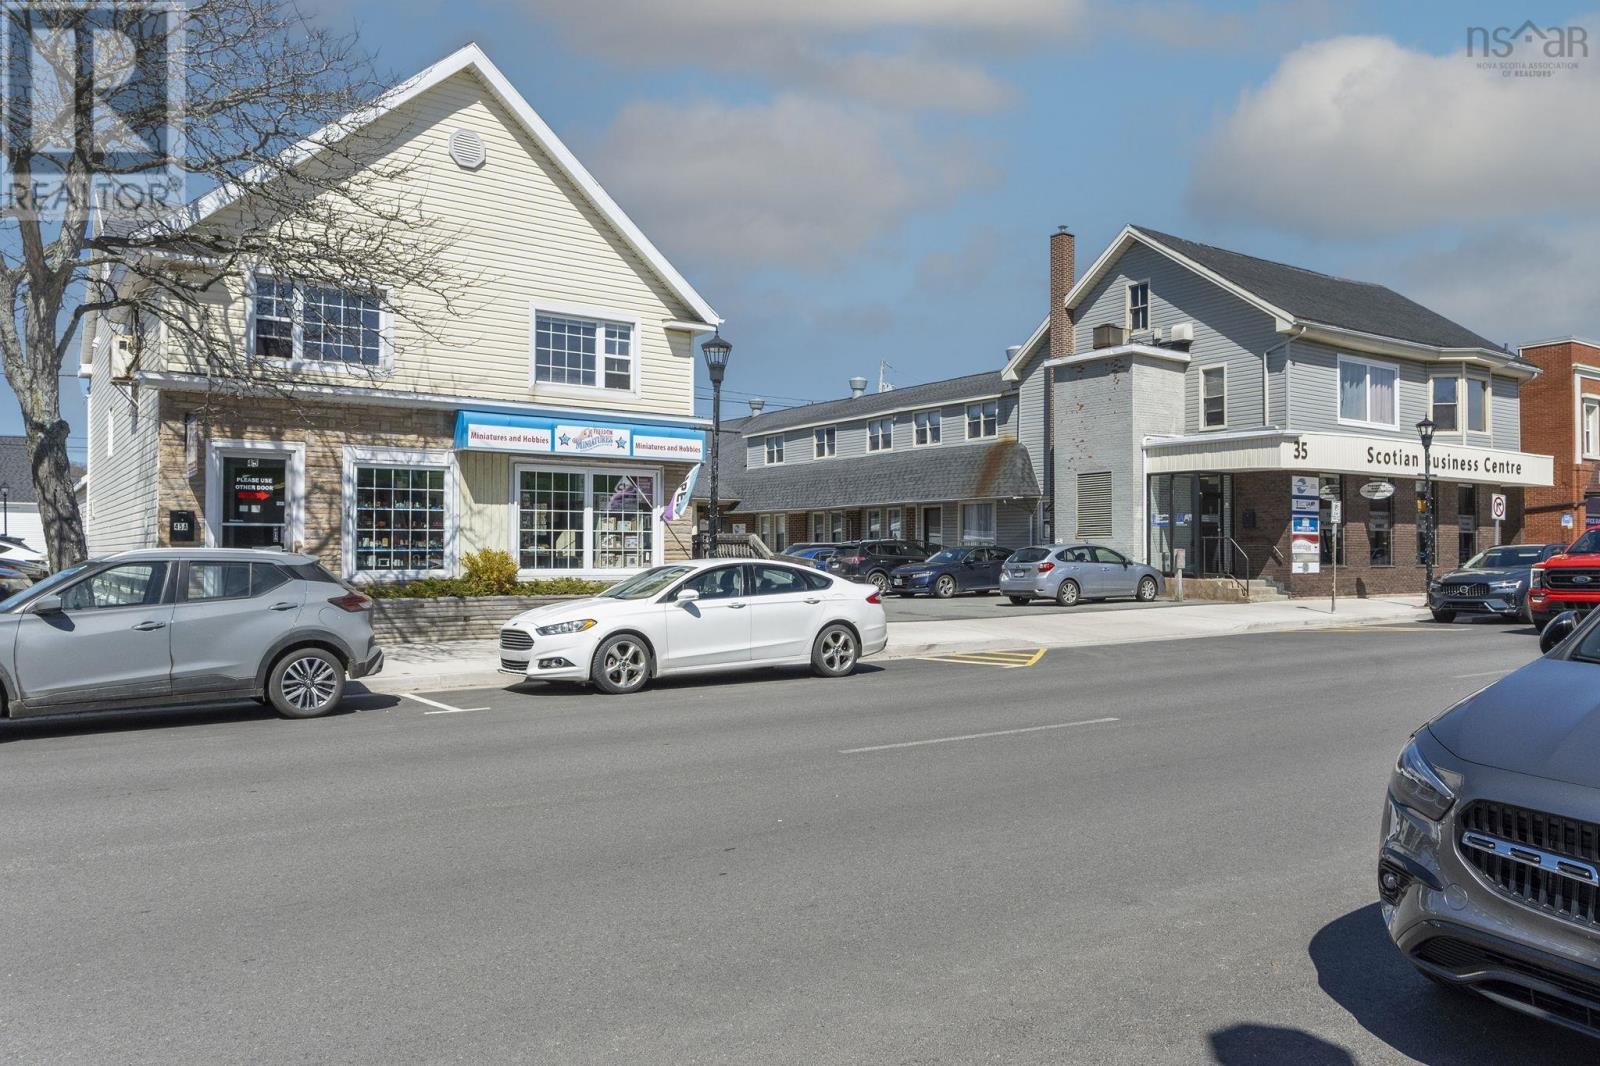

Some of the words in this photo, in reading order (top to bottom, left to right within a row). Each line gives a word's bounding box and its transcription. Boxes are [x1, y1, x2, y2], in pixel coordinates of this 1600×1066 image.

[470, 431, 507, 442] Miniatures
[522, 435, 549, 444] Hobbies
[635, 442, 666, 451] Miniatures
[679, 445, 701, 453] Hobbies
[1293, 441, 1308, 460] 35
[1367, 446, 1419, 467] Scotian
[1484, 457, 1522, 475] Centre
